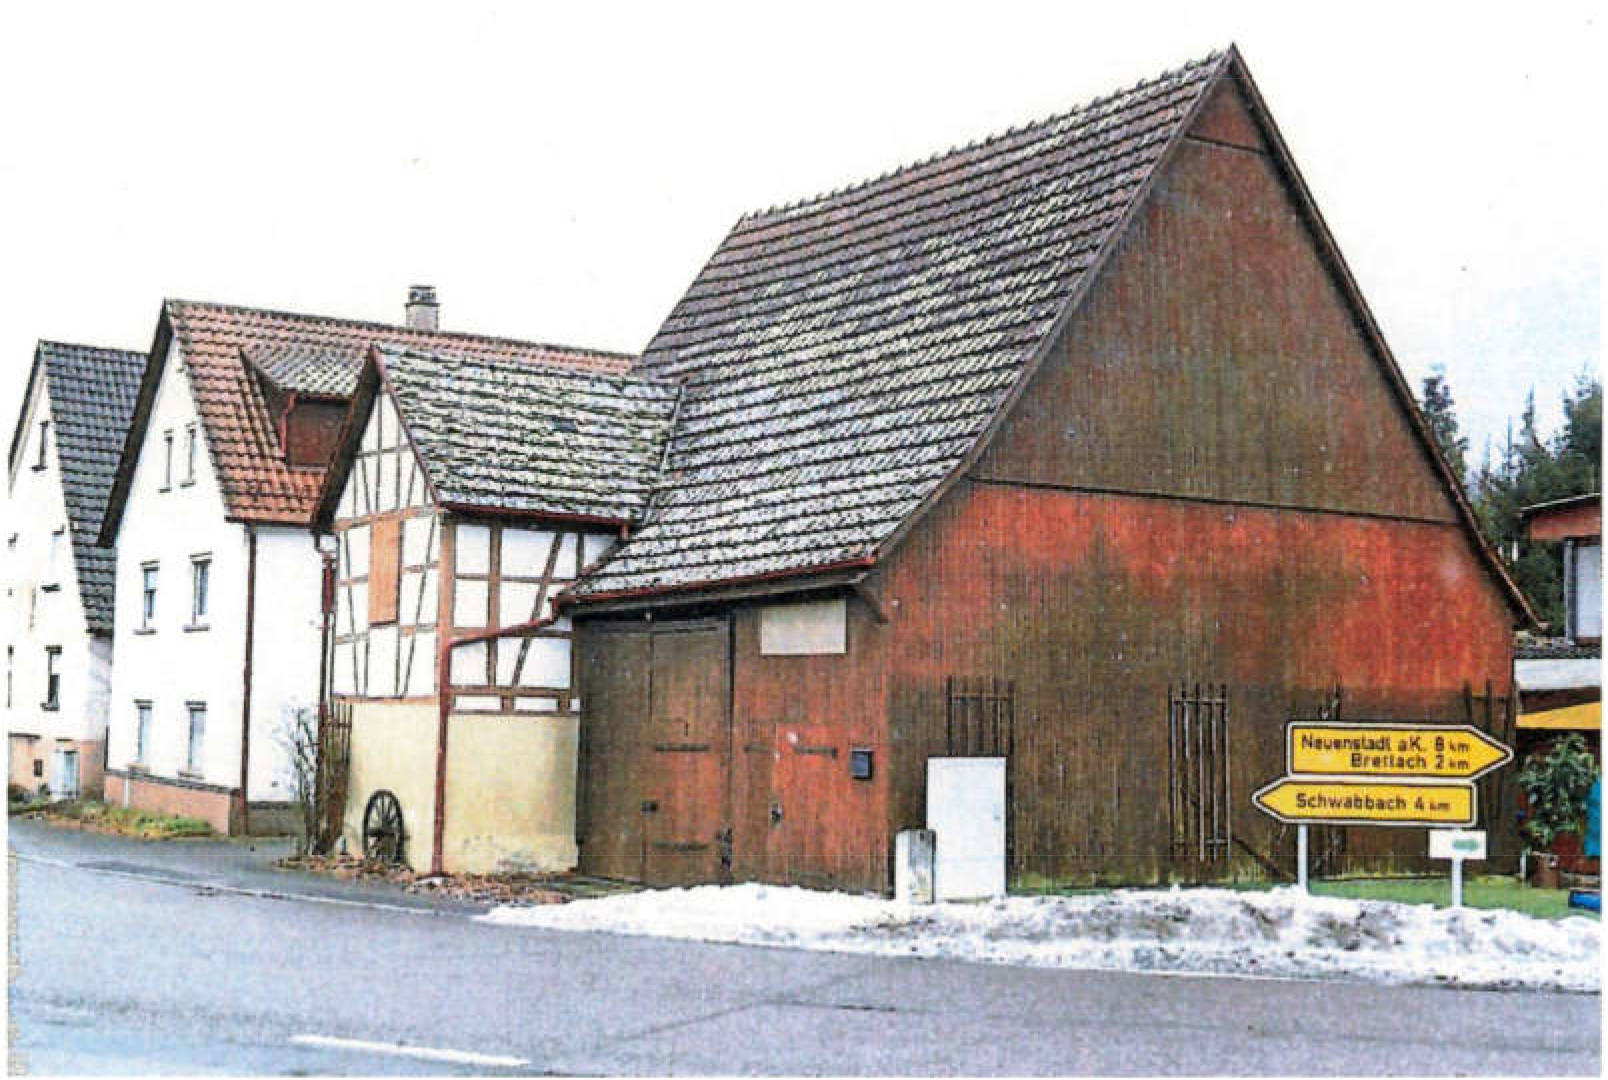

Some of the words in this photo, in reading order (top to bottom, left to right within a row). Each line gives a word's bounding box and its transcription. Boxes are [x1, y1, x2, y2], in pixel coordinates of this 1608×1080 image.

[1301, 734, 1391, 751] Neuenstadt
[1435, 735, 1445, 752] 8
[1449, 740, 1469, 752] km
[1435, 754, 1444, 769] 2
[1449, 757, 1469, 769] km
[1296, 792, 1406, 810] Schwabbach
[1415, 796, 1425, 810] 4
[1430, 800, 1450, 811] km
